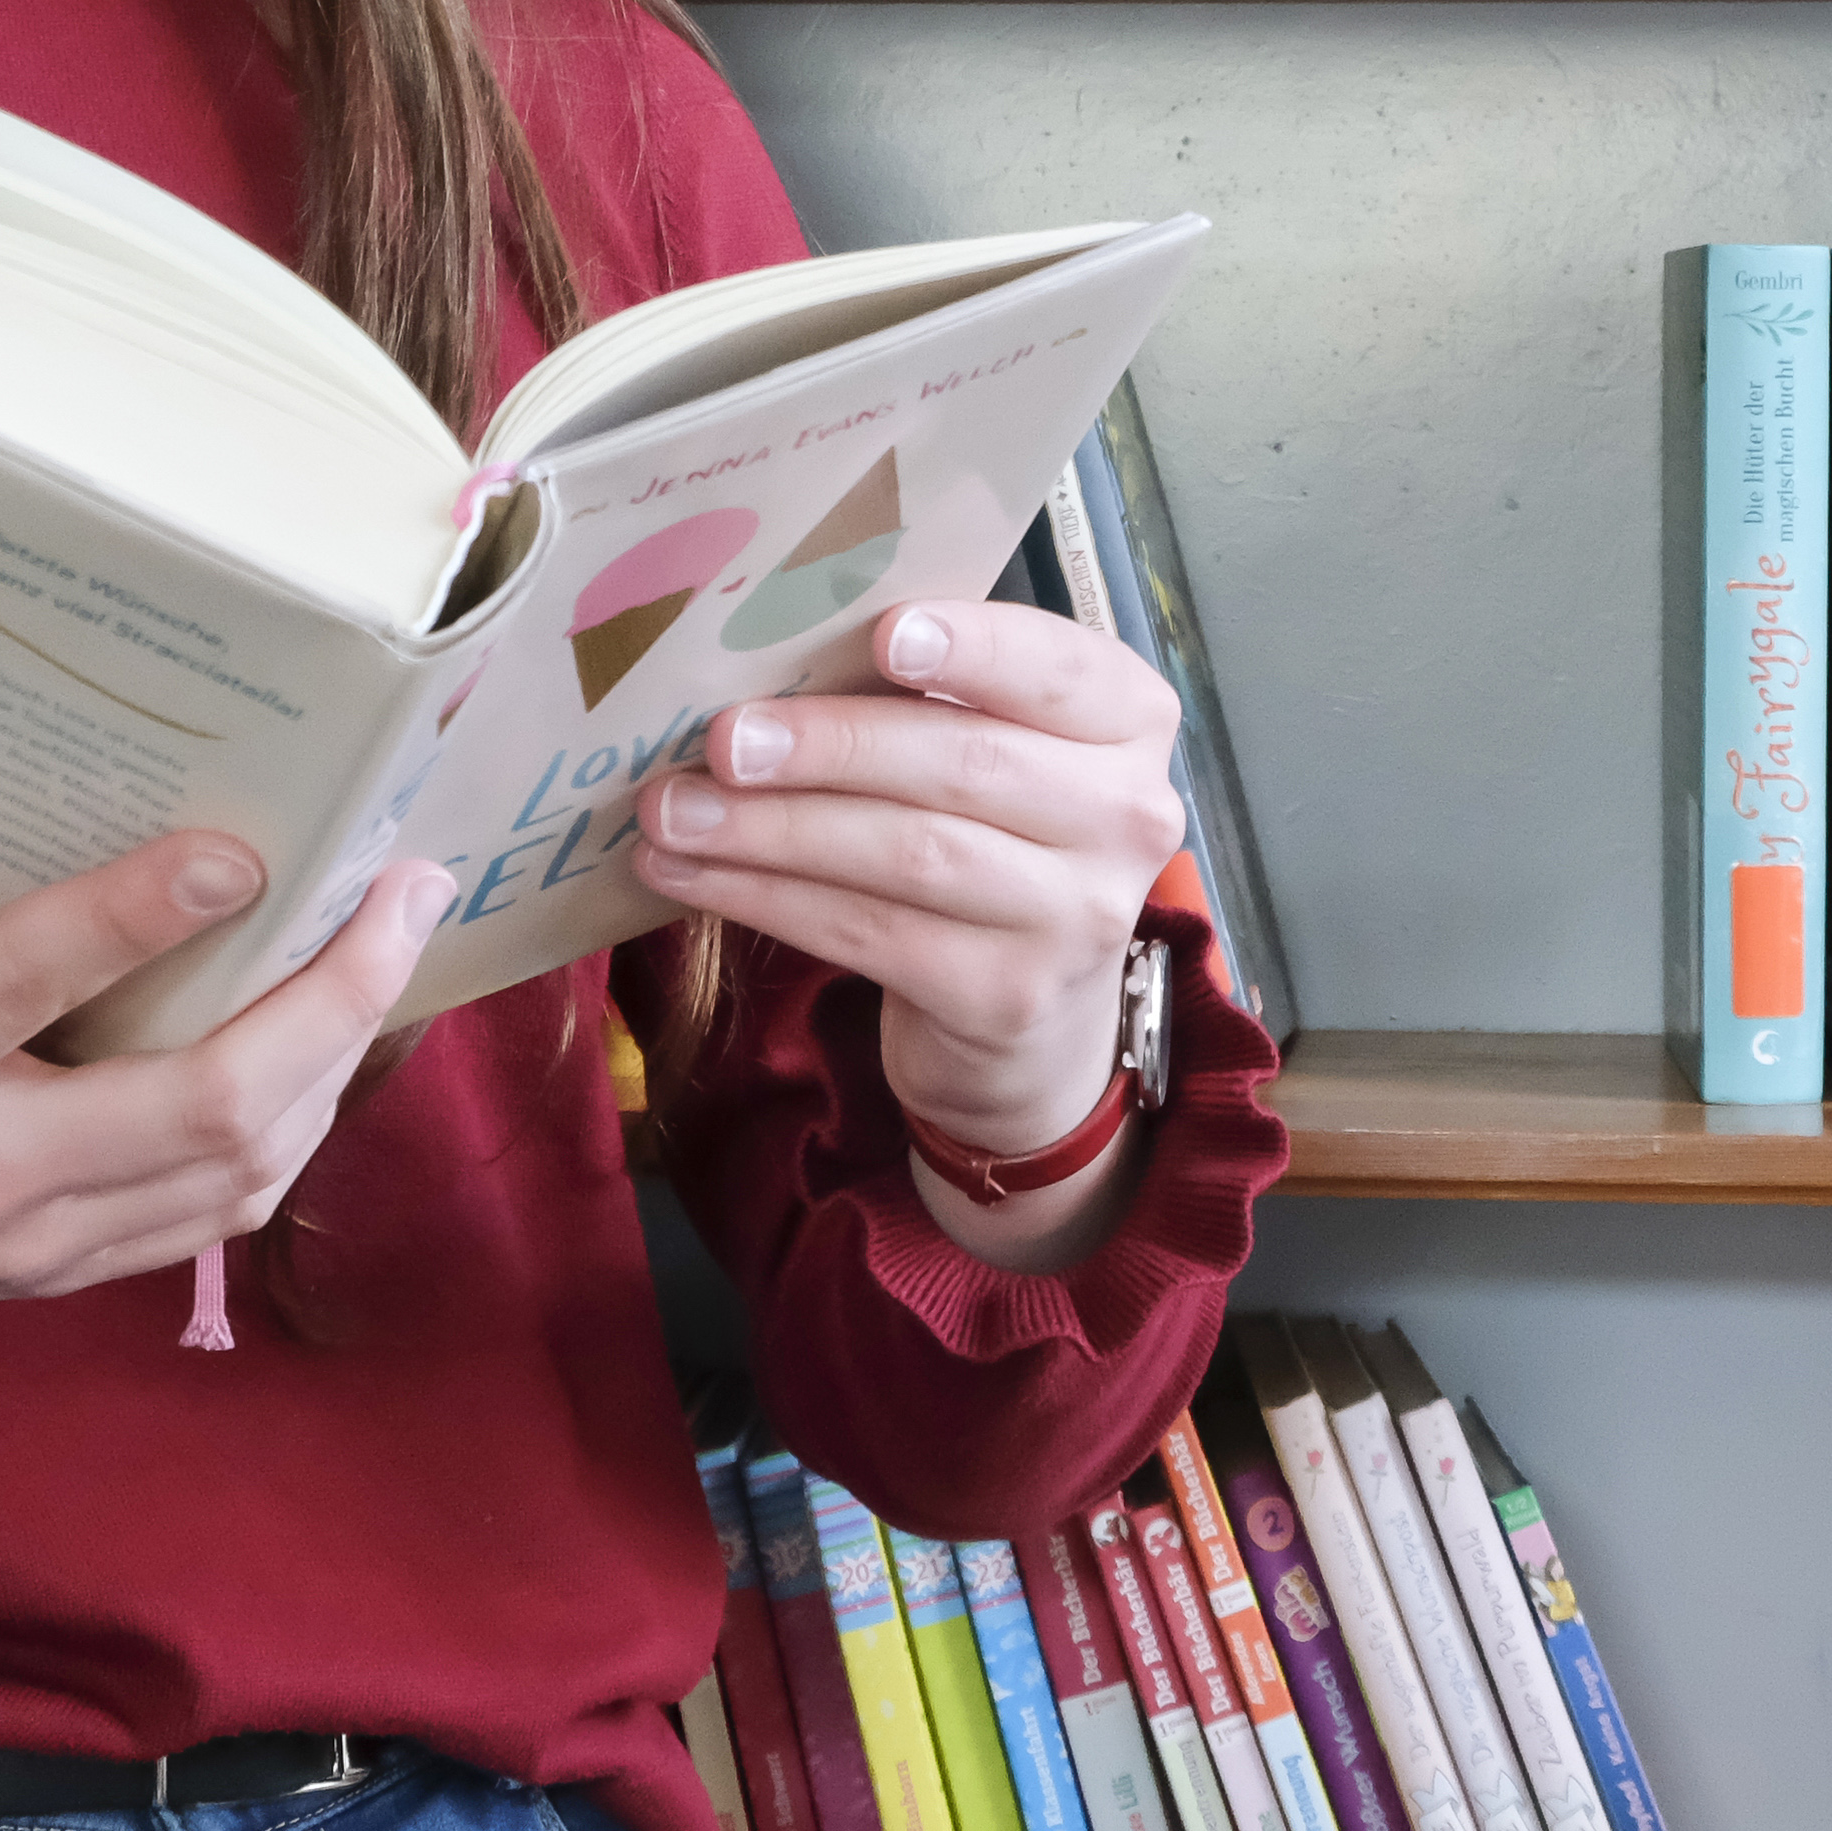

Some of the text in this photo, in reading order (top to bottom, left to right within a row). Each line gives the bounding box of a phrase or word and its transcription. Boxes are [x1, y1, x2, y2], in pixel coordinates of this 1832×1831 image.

[1733, 271, 1805, 292] Gembri
[630, 445, 775, 507] JENNA
[1739, 379, 1766, 525] Die Hüter der
[1773, 357, 1800, 543] magischen Bucht
[1056, 503, 1081, 547] TIERE
[1724, 551, 1812, 820] Fairygale
[1259, 1509, 1286, 1540] 2
[841, 1562, 871, 1589] 20
[917, 1557, 942, 1582] 21
[975, 1559, 1007, 1587] 22
[1114, 1554, 1179, 1710] Der Bücherbär
[1167, 1562, 1233, 1715] Der Bücherbär
